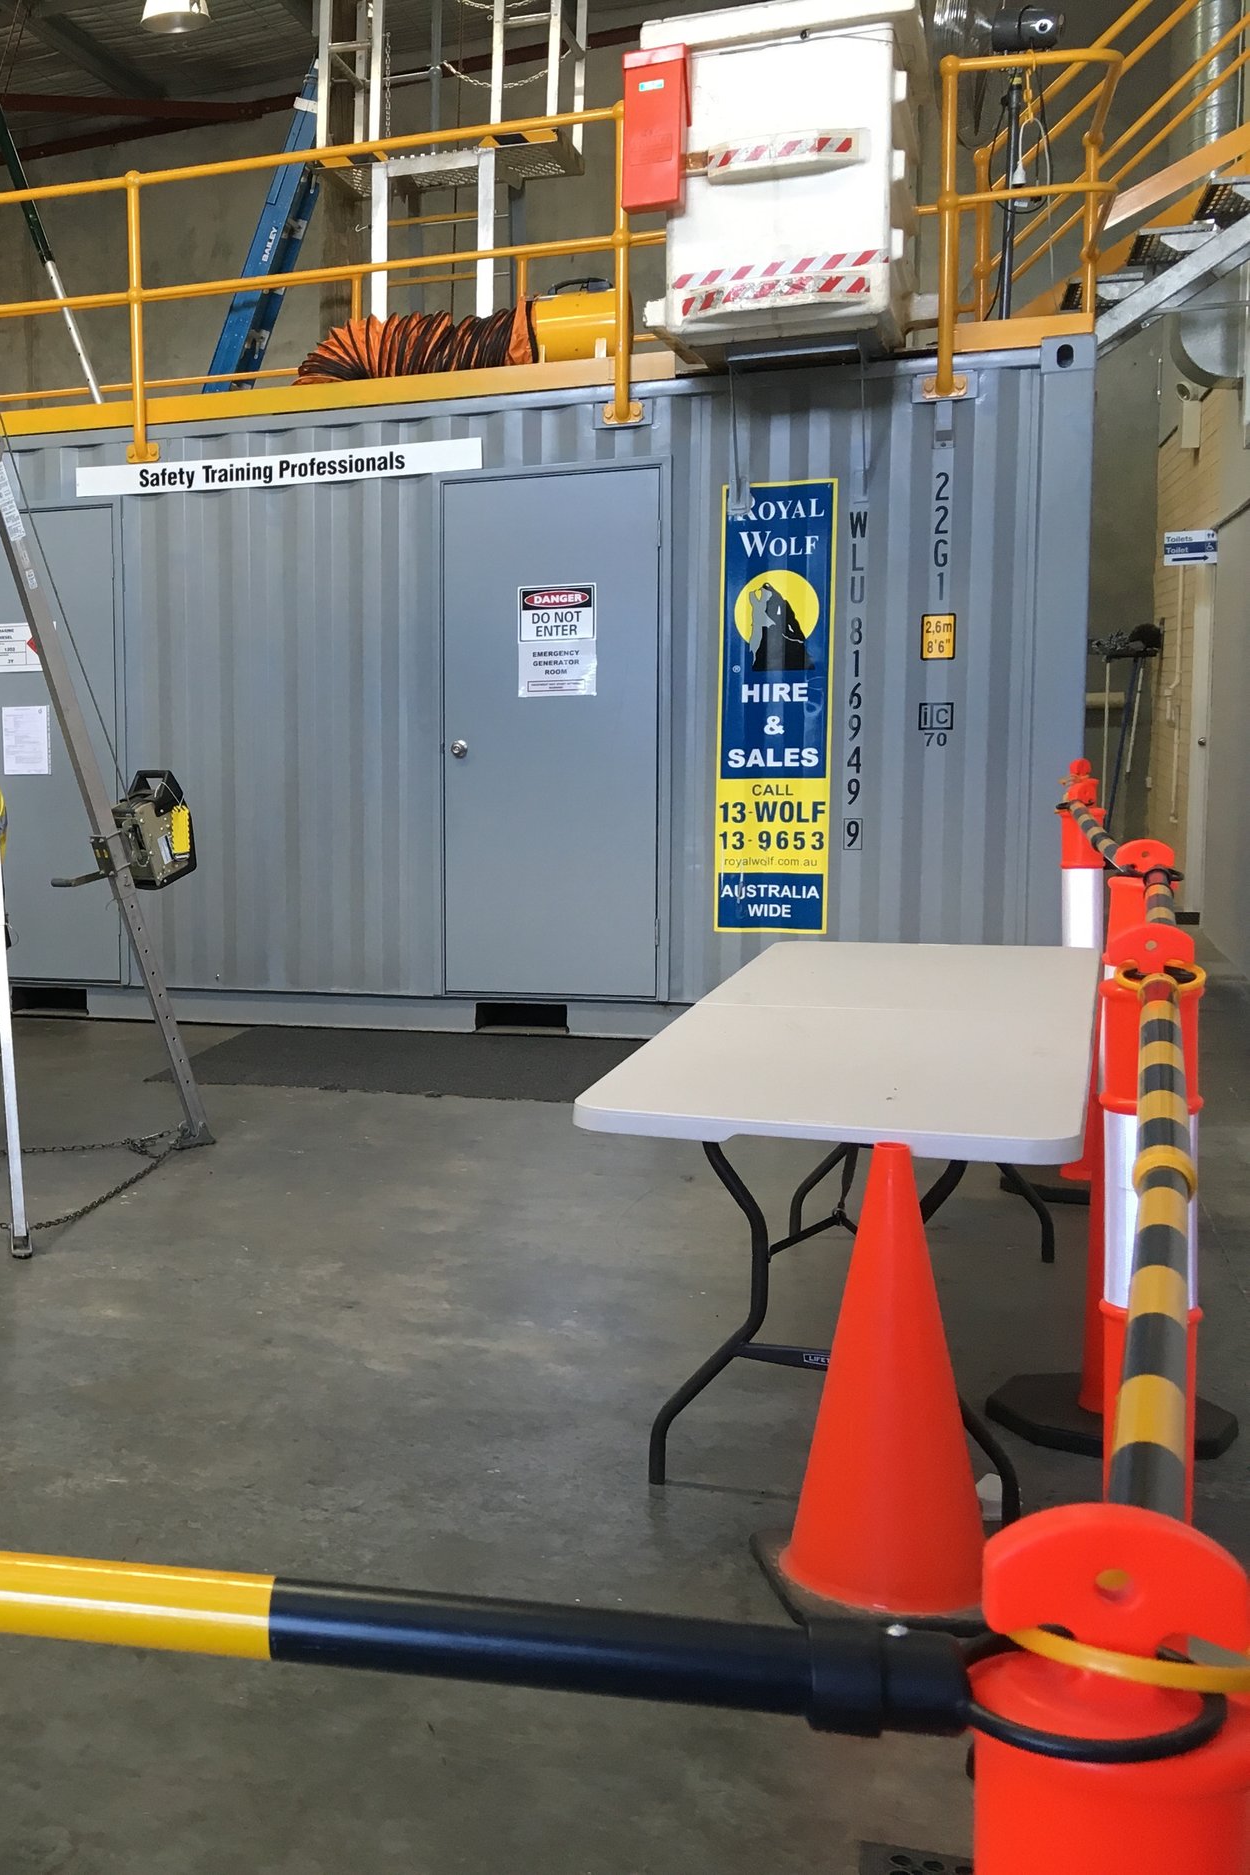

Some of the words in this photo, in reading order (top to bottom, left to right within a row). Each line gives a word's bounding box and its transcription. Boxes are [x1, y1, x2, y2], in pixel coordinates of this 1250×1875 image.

[261, 226, 278, 262] BAILEY
[138, 467, 195, 489] Safety
[203, 463, 273, 483] Training
[279, 452, 406, 478] Professionals
[934, 472, 950, 601] 22G1
[739, 531, 819, 558] WOLF
[533, 593, 582, 604] DANGER
[532, 612, 551, 624] DO
[554, 611, 582, 623] NOT
[536, 624, 578, 637] ENTER
[532, 650, 580, 658] EMERGENCY
[533, 659, 580, 667] GENERATOR
[741, 683, 809, 703] HIRE
[847, 617, 863, 805] 816949
[763, 715, 785, 735] &
[924, 733, 947, 746] 70
[727, 748, 819, 768] SALES
[752, 784, 794, 796] CALL
[846, 821, 860, 848] 9
[724, 856, 818, 868] royalwolf.com.au
[721, 884, 820, 899] AUSTRALIA
[747, 904, 792, 917] WIDE
